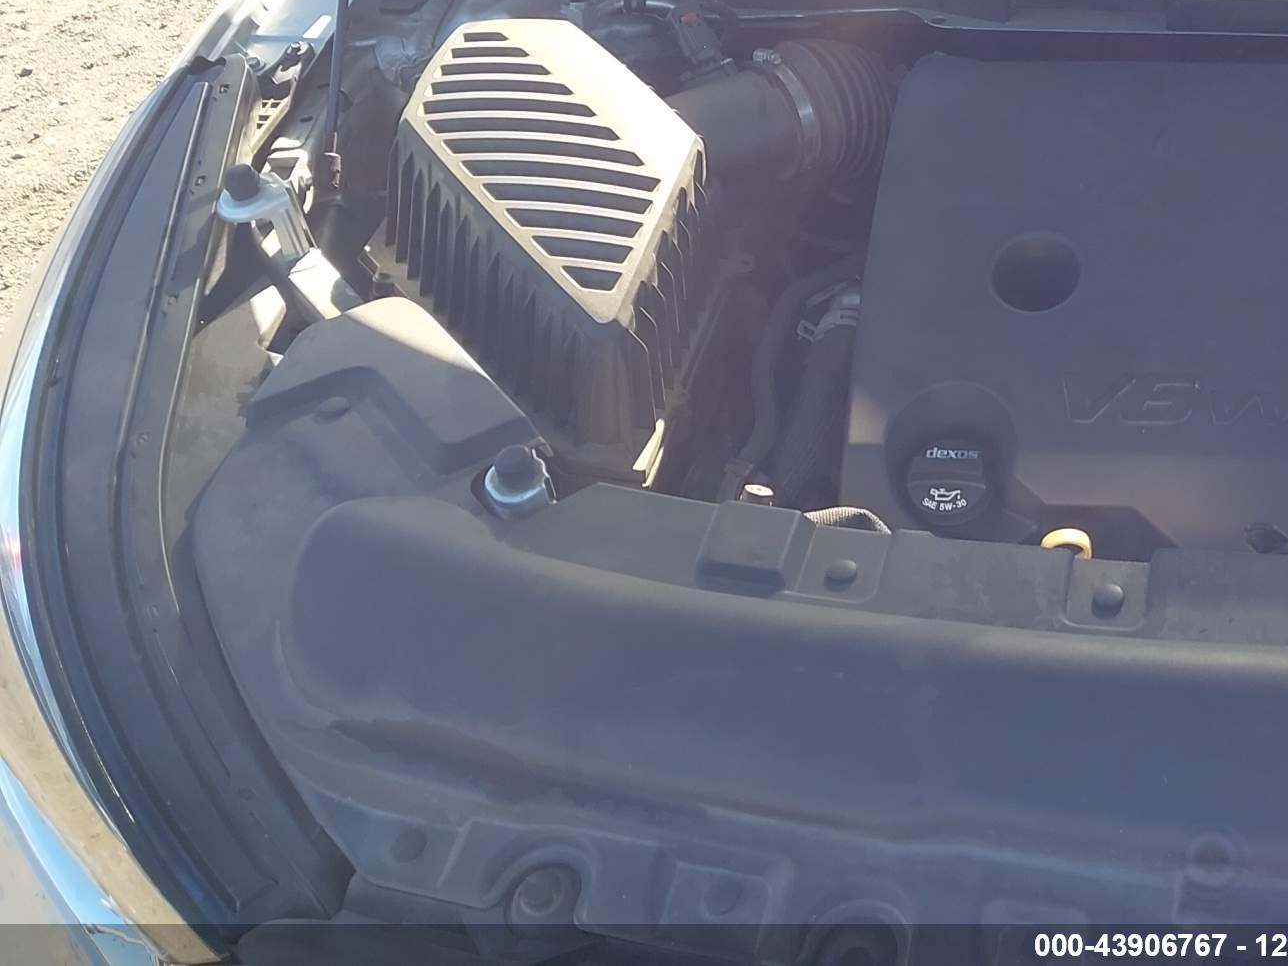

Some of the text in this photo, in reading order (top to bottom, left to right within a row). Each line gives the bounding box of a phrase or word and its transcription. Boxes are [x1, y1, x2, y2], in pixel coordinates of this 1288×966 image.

[926, 447, 978, 459] dexos
[922, 497, 968, 511] SAE 5W-30
